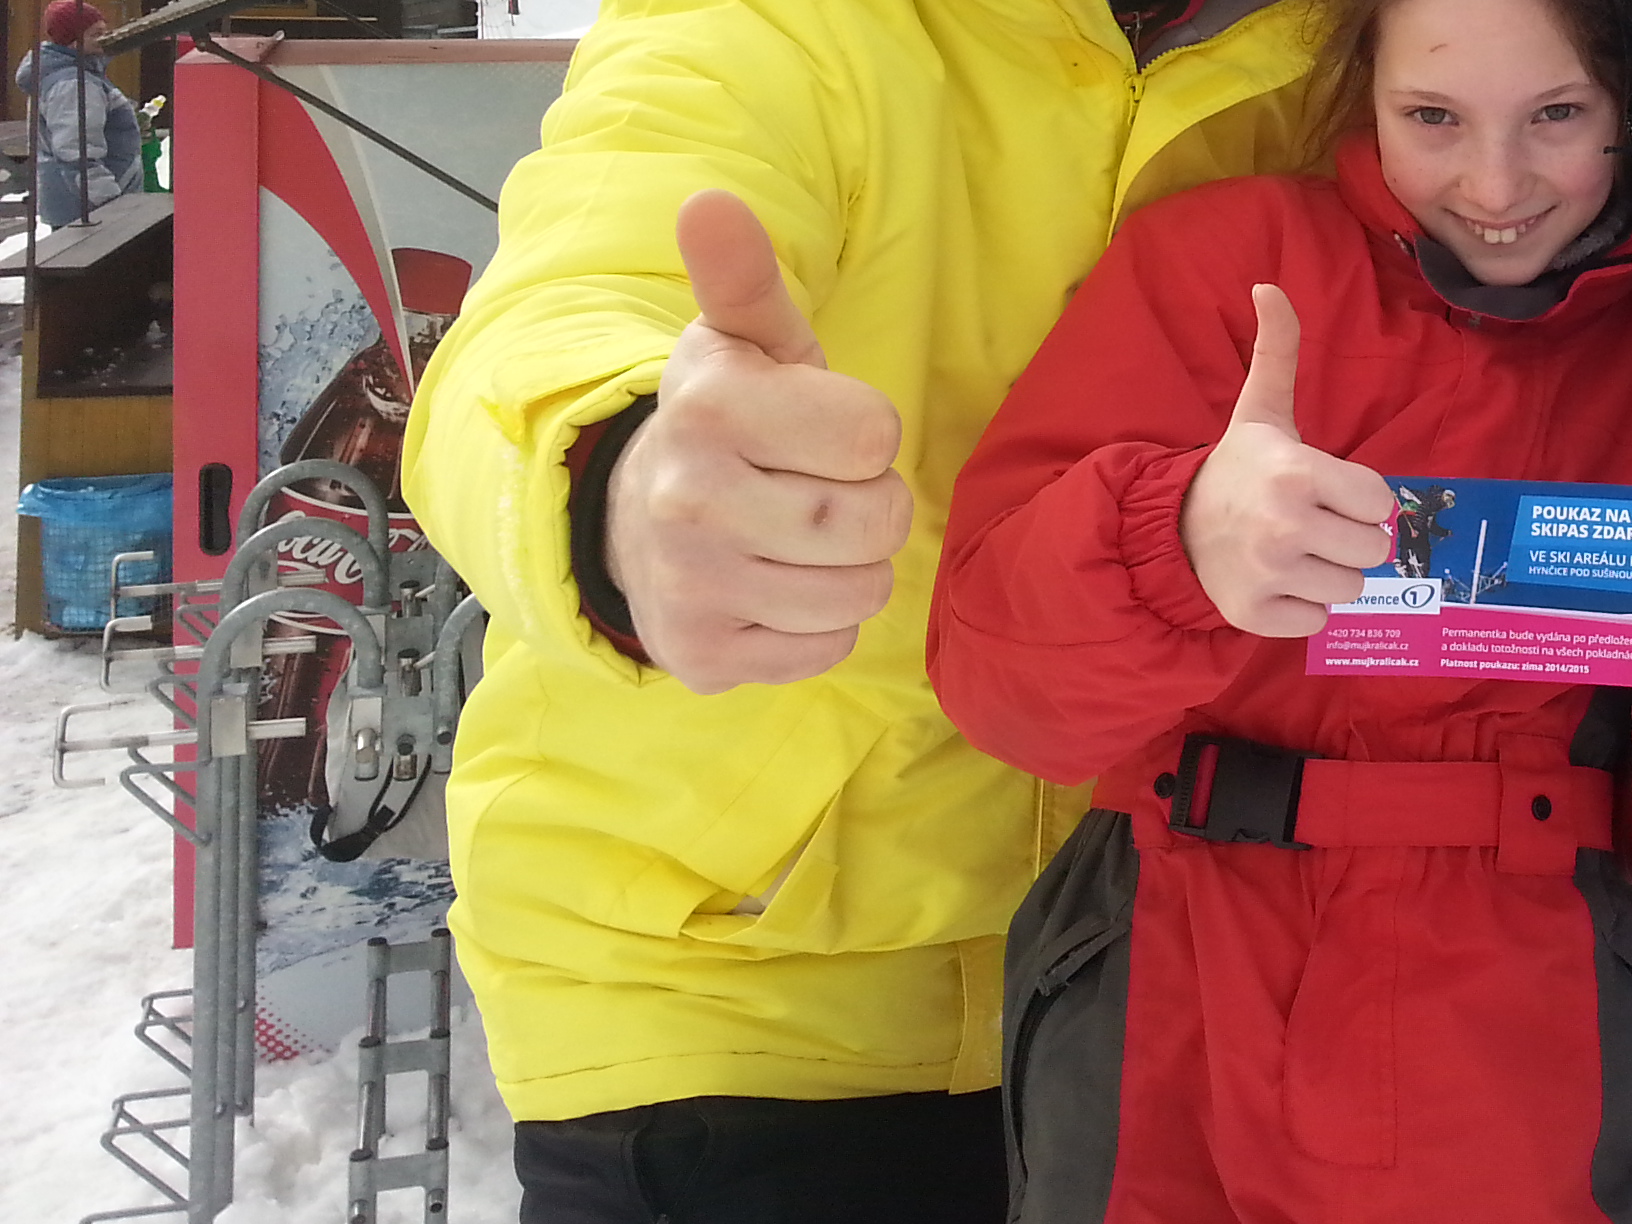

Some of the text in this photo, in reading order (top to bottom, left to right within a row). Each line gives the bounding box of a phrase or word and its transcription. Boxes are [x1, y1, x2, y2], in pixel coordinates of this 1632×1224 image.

[1532, 505, 1602, 522] POUKAZ
[1605, 508, 1631, 524] NA
[1531, 523, 1588, 539] SKIPAS
[1529, 550, 1547, 563] VE
[1550, 551, 1571, 564] SKI
[1573, 551, 1627, 567] AREÁLU
[1529, 565, 1568, 577] HYNČICE
[1570, 568, 1590, 578] POD
[1350, 595, 1400, 605] kvence
[1350, 629, 1366, 638] 734
[1442, 627, 1507, 639] Permanentka
[1509, 629, 1534, 640] bude
[1536, 631, 1571, 643] vydána
[1573, 635, 1586, 644] po
[1450, 642, 1489, 653] dokladu
[1542, 647, 1554, 656] na
[1556, 646, 1583, 657] všech
[1440, 658, 1589, 674] Platnost poukazu: zima 2014/2015
